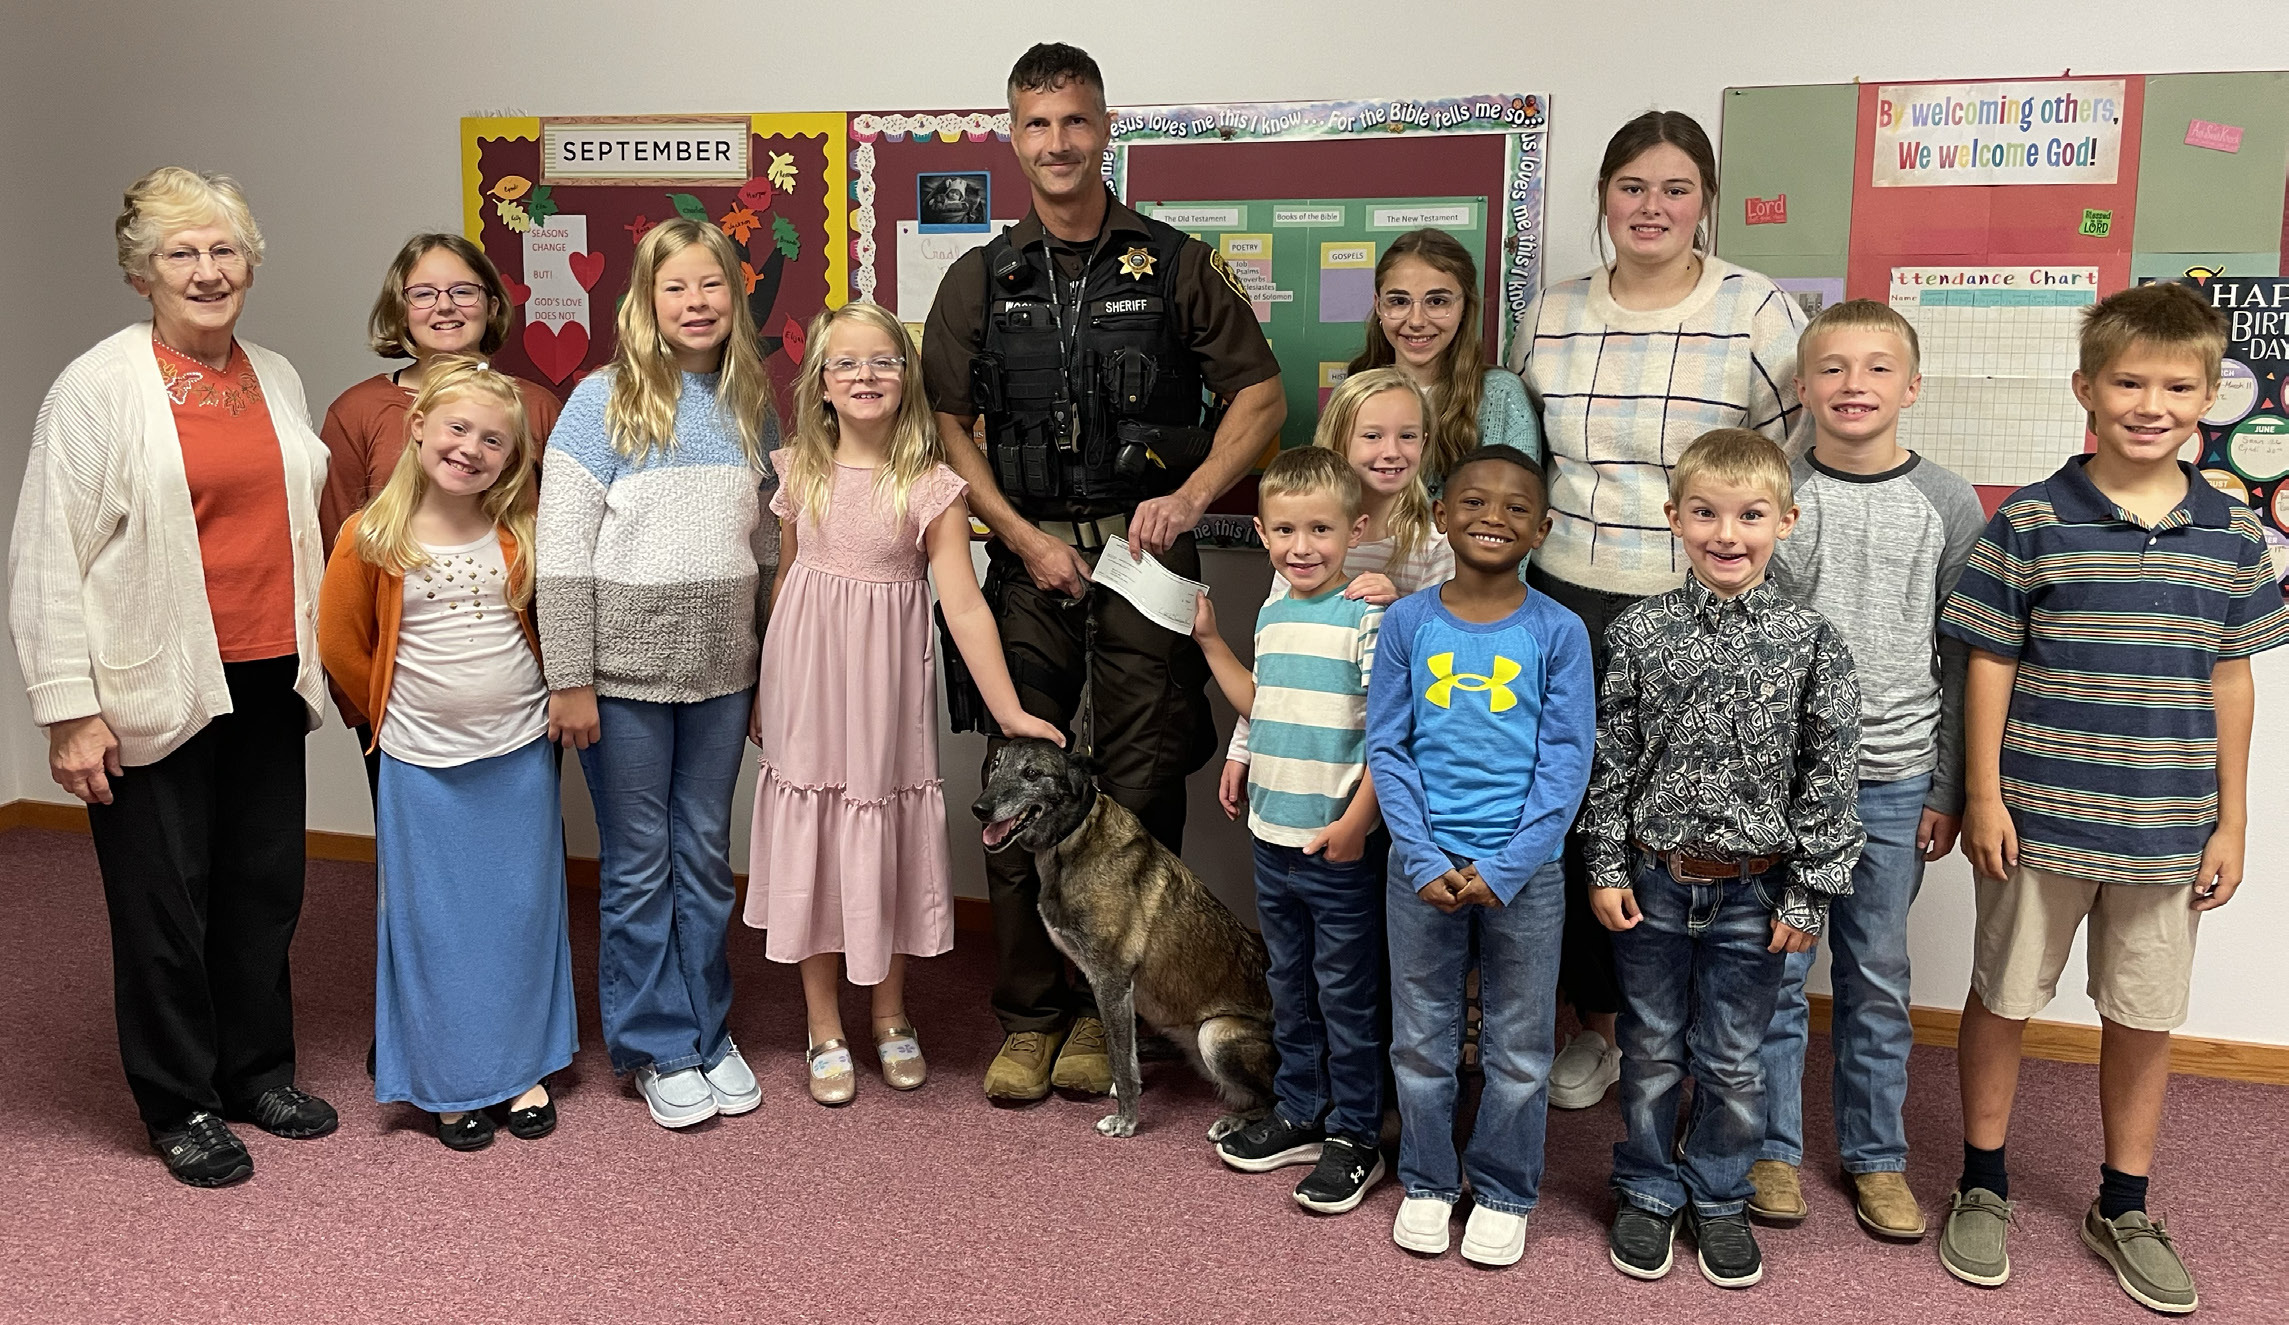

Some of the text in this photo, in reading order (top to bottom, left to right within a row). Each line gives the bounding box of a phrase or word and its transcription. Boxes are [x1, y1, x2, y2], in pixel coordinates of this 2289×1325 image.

[1879, 93, 2118, 133] By welcoming others,
[1110, 114, 1144, 138] esus
[1149, 112, 1187, 138] loves
[1192, 114, 1215, 135] me
[1218, 109, 1247, 128] this
[1250, 115, 1257, 133] I
[1327, 110, 1355, 132] For
[1359, 106, 1386, 129] the
[1389, 102, 1430, 127] Bible
[1434, 103, 1471, 130] tells
[1475, 102, 1502, 119] me
[563, 140, 731, 161] SEPTEMBER
[1898, 136, 2097, 170] We welcome God!
[1511, 156, 1541, 201] loves
[1747, 194, 1785, 217] Lord
[1164, 214, 1227, 223] The Old Testament
[1276, 212, 1338, 221] Books of the Bible
[1387, 213, 1459, 223] The New Testament
[1511, 204, 1533, 232] me
[532, 229, 569, 238] SEASONS
[2084, 222, 2109, 234] LORD
[532, 243, 567, 252] CHANGE
[1231, 244, 1259, 252] POETRY
[1514, 233, 1539, 268] this
[1331, 252, 1364, 261] GOSPELS
[1890, 269, 2097, 285] ttendance Chart
[534, 297, 582, 307] GOD'S LOVE
[1262, 293, 1292, 301] Solomon
[1891, 294, 1918, 302] Name
[1105, 299, 1148, 313] SHERIFF
[535, 311, 576, 320] DOES NOT
[2254, 425, 2276, 433] JUNE
[1215, 520, 1243, 539] this
